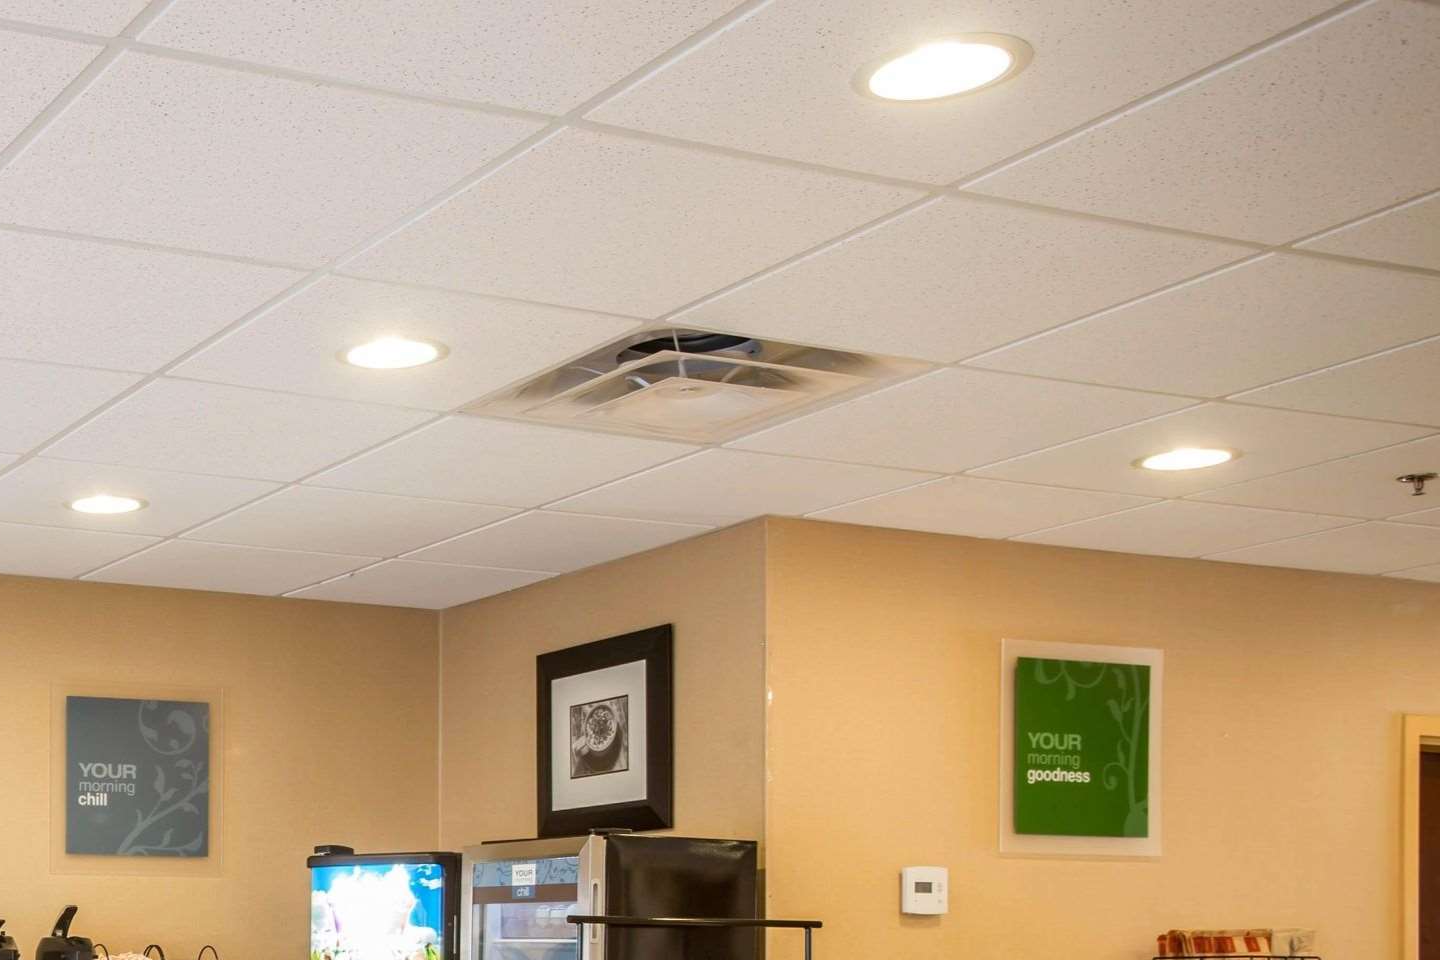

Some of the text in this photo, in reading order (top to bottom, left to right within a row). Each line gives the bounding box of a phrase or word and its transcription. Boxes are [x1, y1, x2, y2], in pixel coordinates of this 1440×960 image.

[1027, 731, 1083, 751] YOUR
[1027, 752, 1081, 770] morning
[78, 761, 138, 780] YOUR
[1026, 767, 1092, 785] goodness
[78, 779, 136, 797] morning
[78, 792, 109, 807] chill
[515, 869, 534, 878] YOUR
